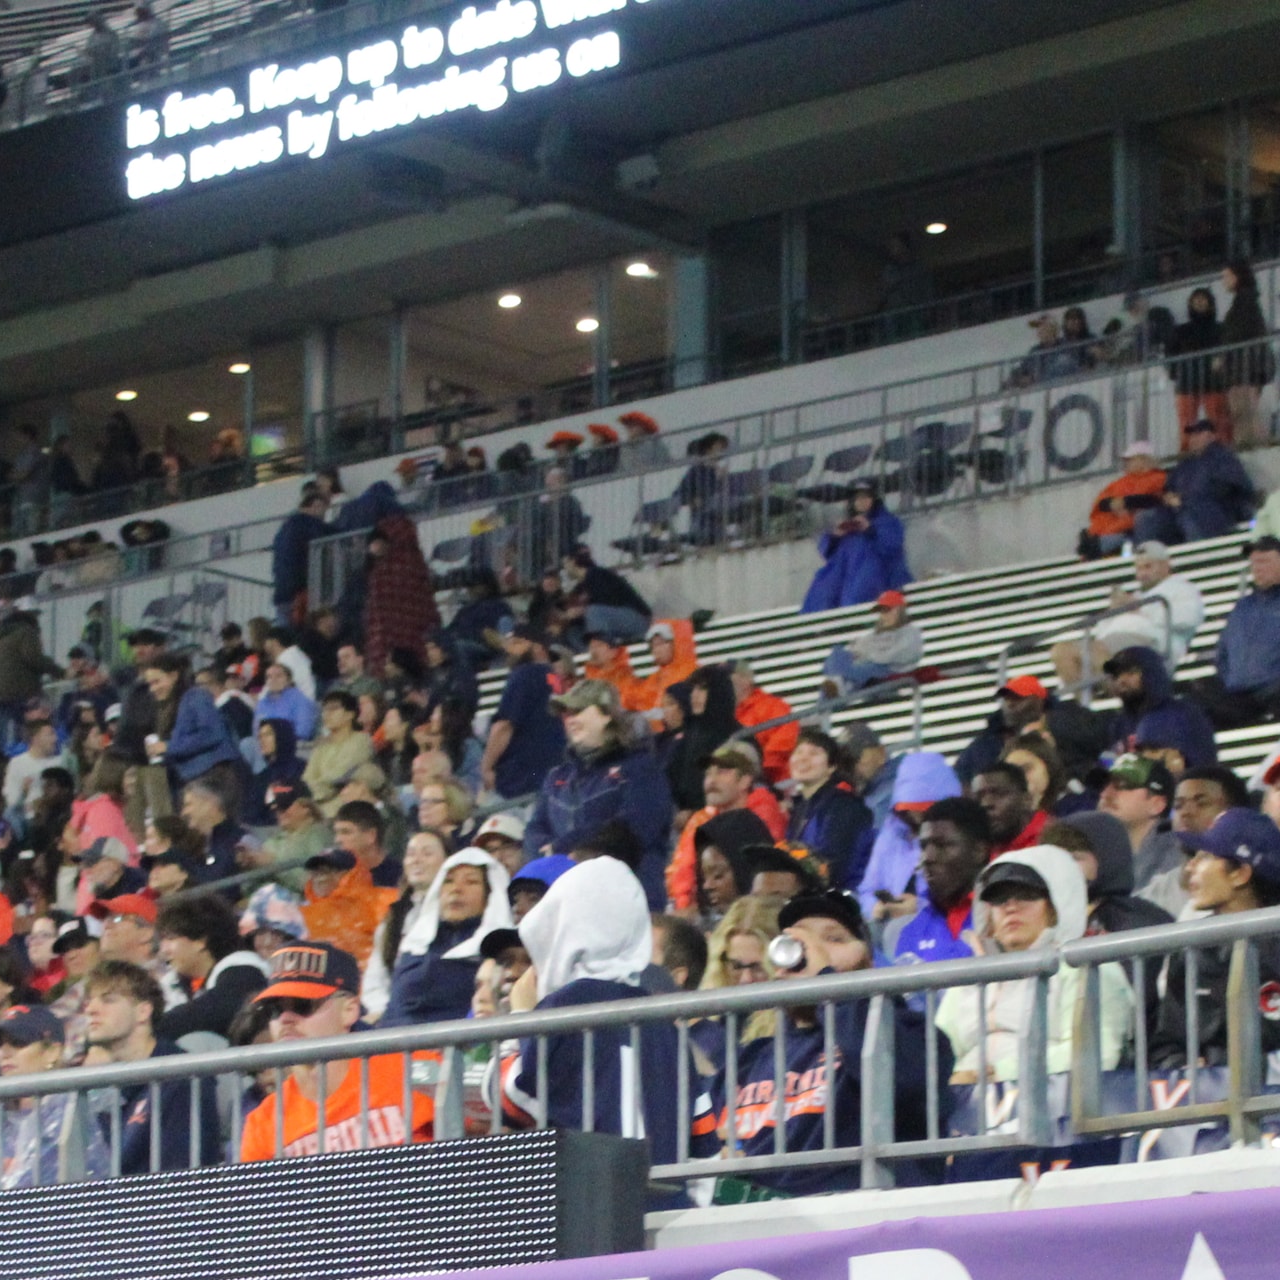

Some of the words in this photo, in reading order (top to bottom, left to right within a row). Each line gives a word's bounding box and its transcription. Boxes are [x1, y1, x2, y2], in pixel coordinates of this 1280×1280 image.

[125, 152, 186, 199] the
[287, 110, 334, 159] by
[336, 56, 508, 141] following
[511, 47, 562, 93] us
[565, 31, 620, 77] on
[126, 105, 161, 149] is
[250, 56, 342, 113] Keep
[348, 40, 398, 87] up
[401, 26, 445, 69] to
[447, 0, 538, 56] date
